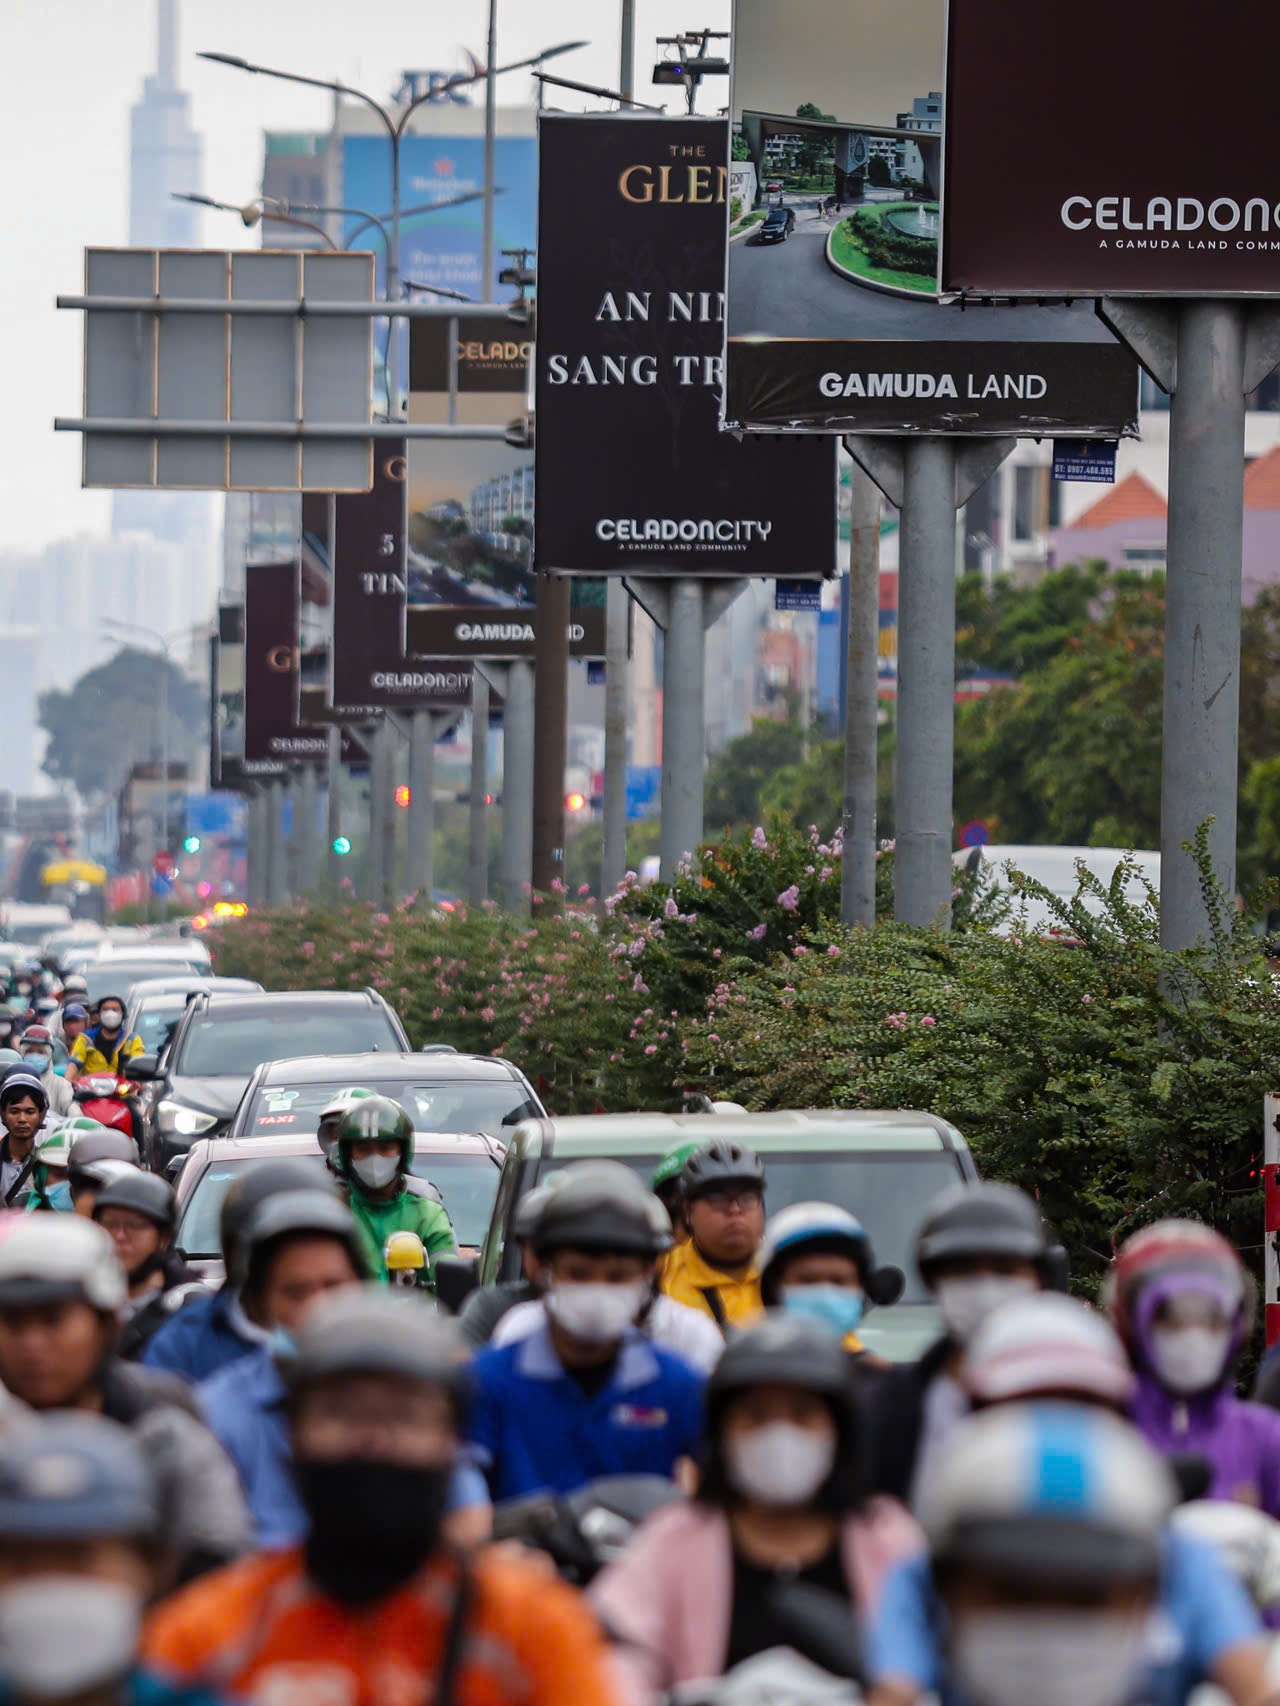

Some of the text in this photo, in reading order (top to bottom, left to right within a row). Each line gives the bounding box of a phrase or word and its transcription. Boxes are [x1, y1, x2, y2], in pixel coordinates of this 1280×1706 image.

[669, 144, 706, 157] THE
[1060, 195, 1280, 232] CELADON
[1099, 239, 1108, 249] A
[1115, 239, 1180, 249] GAMUDA
[1188, 240, 1228, 250] LAND
[595, 291, 652, 322] AN
[548, 354, 658, 385] SANG
[819, 372, 1048, 399] GAMUDA LAND
[596, 518, 772, 541] CELADONCITY
[455, 623, 536, 641] GAMUDA
[371, 672, 475, 689] CELADONCIT
[257, 1114, 296, 1125] TAXI
